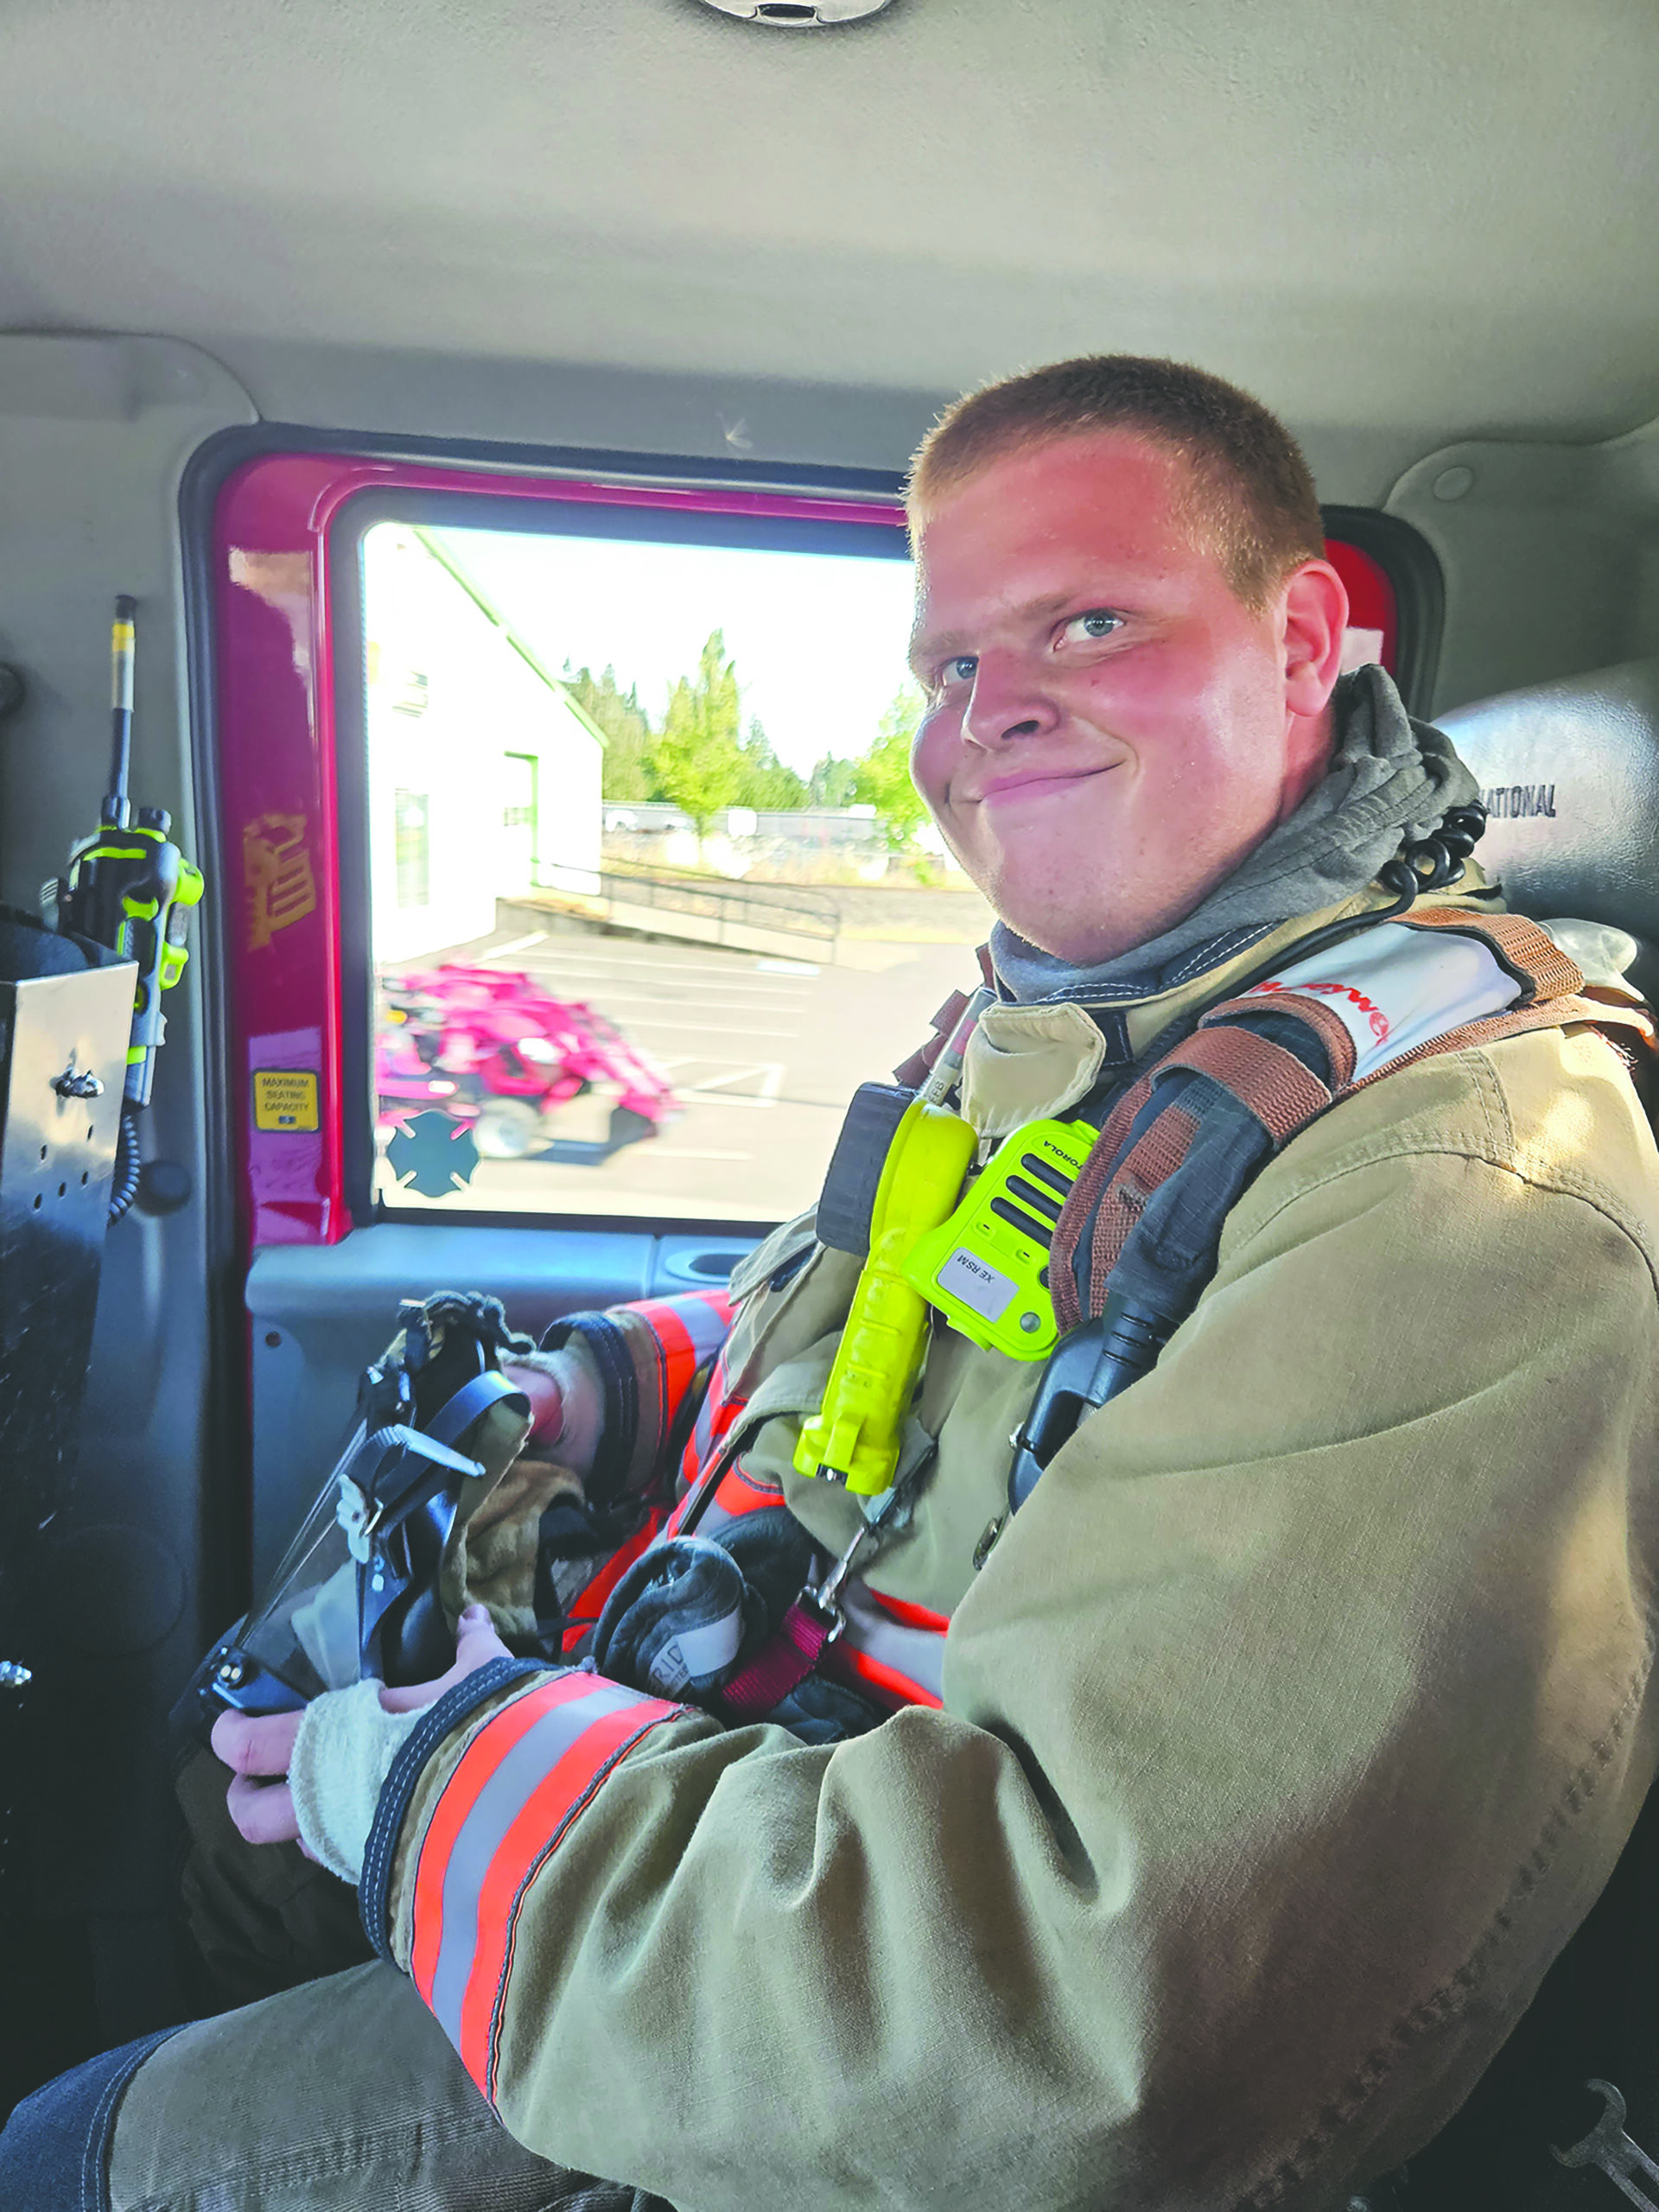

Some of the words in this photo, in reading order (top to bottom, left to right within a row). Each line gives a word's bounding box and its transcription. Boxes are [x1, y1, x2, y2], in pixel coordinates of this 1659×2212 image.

[263, 1077, 309, 1088] MAXIMUM
[266, 1090, 307, 1100] SEATING
[264, 1102, 309, 1112] CAPACITY
[957, 1255, 982, 1274] RSM
[979, 1270, 995, 1284] XE
